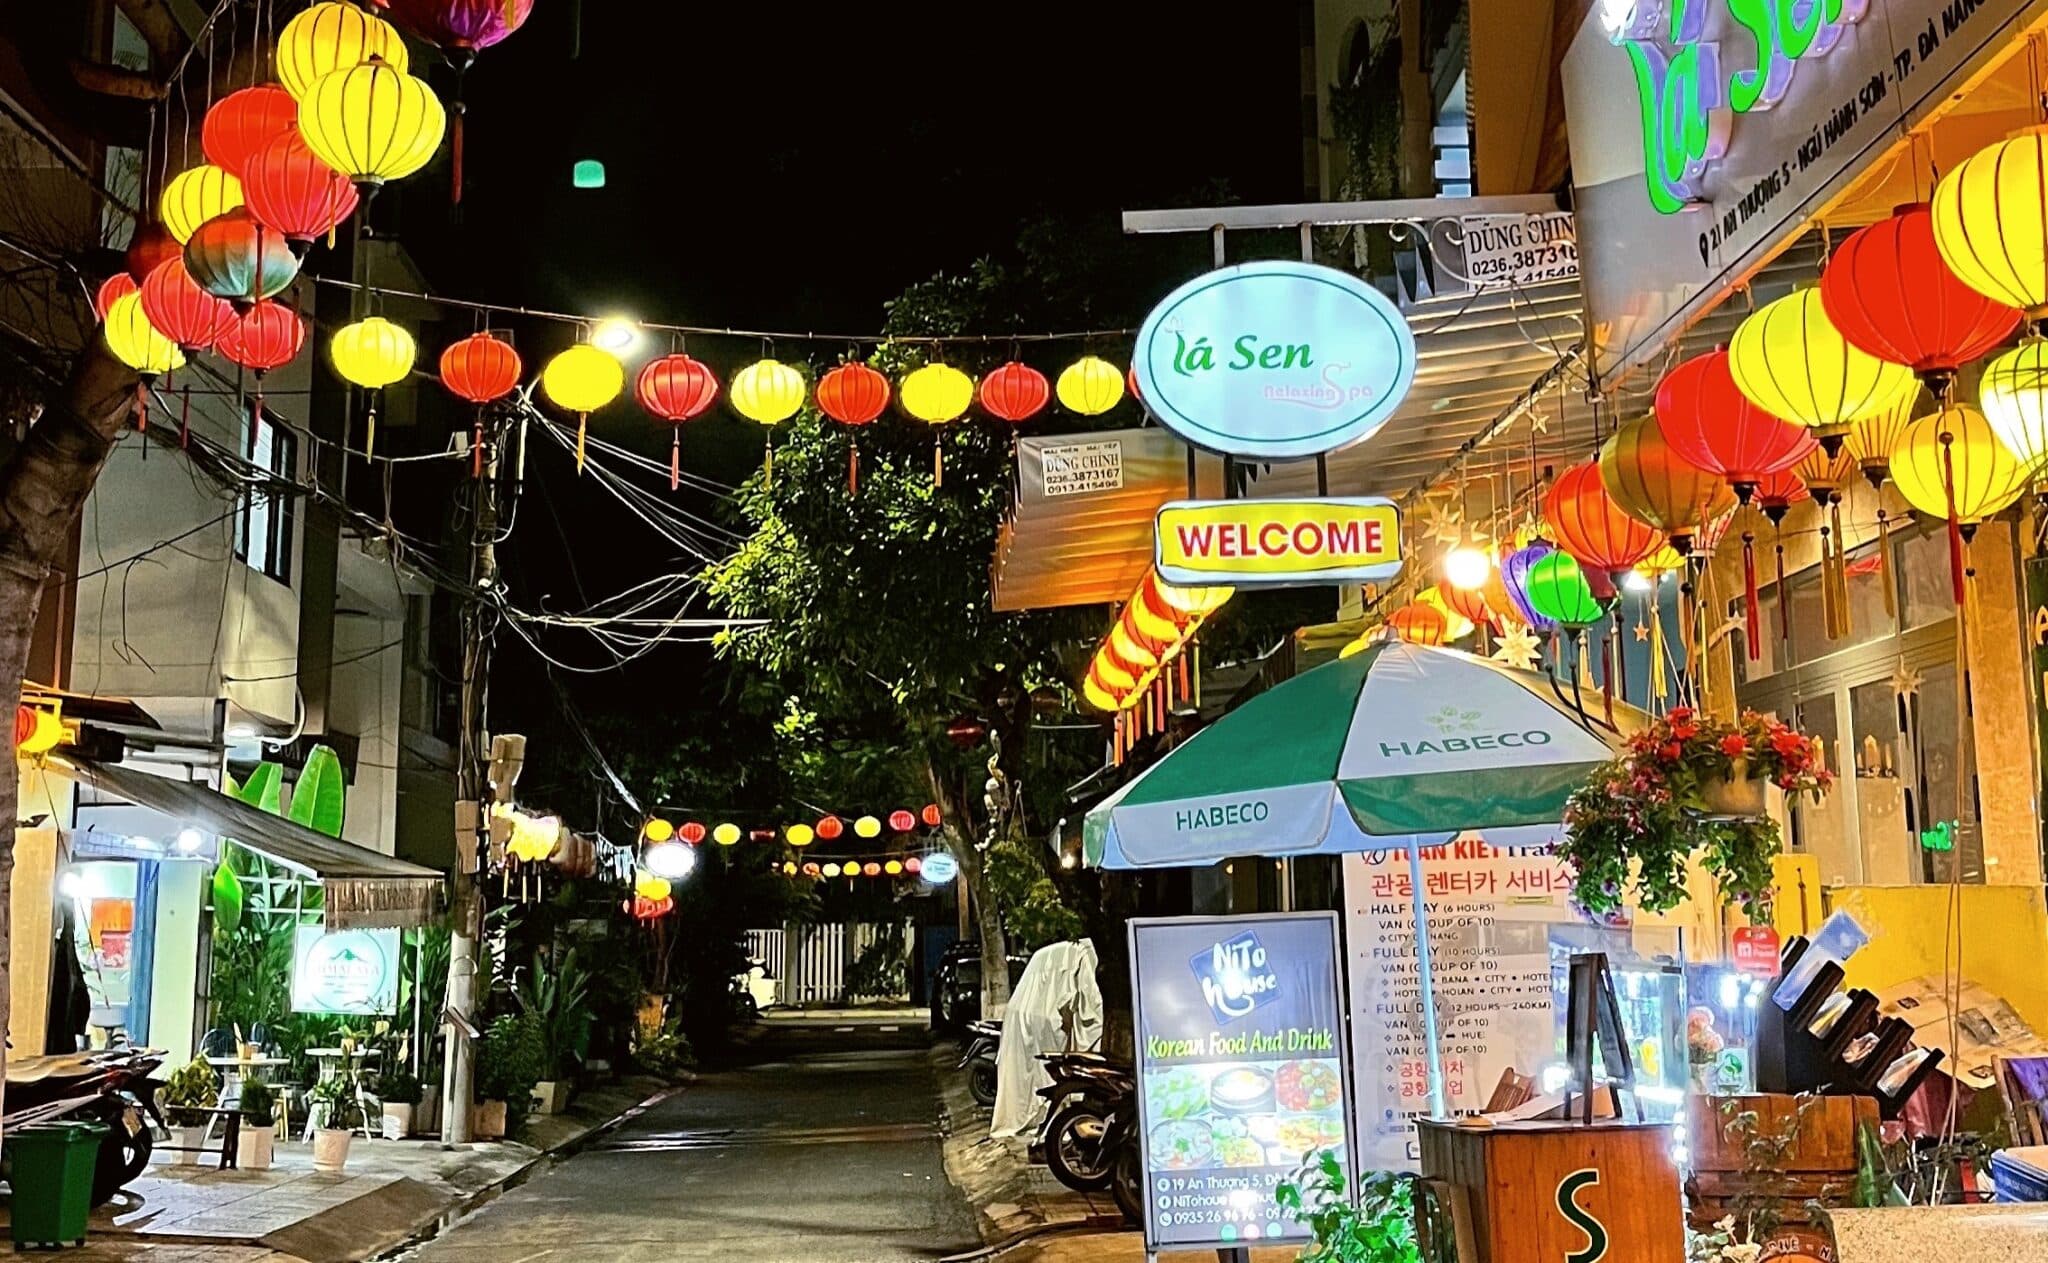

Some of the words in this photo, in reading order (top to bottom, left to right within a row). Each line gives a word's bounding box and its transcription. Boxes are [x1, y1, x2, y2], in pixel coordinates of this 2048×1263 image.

[1710, 223, 1721, 251] 21
[1782, 161, 1790, 186] 5
[1468, 221, 1523, 255] DŨNG
[1228, 334, 1313, 370] Sen
[1264, 384, 1338, 402] Relaxing
[1177, 521, 1383, 558] WELCOME
[1379, 730, 1552, 758] HABECO
[1176, 801, 1269, 831] HABECO
[1427, 869, 1498, 896] 렌터카
[1505, 867, 1573, 894] 서비스
[1371, 902, 1407, 916] HALF
[1412, 902, 1439, 914] AY
[1443, 905, 1454, 914] (6
[1456, 903, 1496, 913] HOURS)
[1379, 920, 1403, 930] VAN
[1407, 918, 1454, 930] (GOUP
[1457, 918, 1474, 928] OF
[1478, 917, 1496, 927] 10)
[1388, 933, 1410, 943] CITY
[1373, 946, 1409, 959] FULL
[1412, 945, 1440, 958] DY
[1462, 947, 1500, 956] HOURS)
[1381, 963, 1405, 974] VAN
[1409, 961, 1457, 974] (GOUP
[1460, 961, 1476, 972] OF
[1480, 960, 1498, 971] 10)
[1394, 976, 1422, 987] HOTE
[1485, 974, 1507, 984] CITY
[1394, 989, 1422, 999] HOTE
[1490, 985, 1512, 995] CITY
[1376, 1002, 1411, 1014] FULL
[1415, 1001, 1442, 1014] DY
[1465, 1002, 1501, 1012] HOURS
[1512, 1001, 1551, 1011] 240KM)
[1384, 1020, 1408, 1030] VAN
[1457, 1018, 1472, 1028] OF
[1474, 1017, 1490, 1027] 10)
[1147, 1034, 1206, 1058] Korean
[1209, 1031, 1247, 1056] Food
[1250, 1029, 1284, 1053] And
[1287, 1027, 1334, 1051] Drink
[1396, 1034, 1411, 1042] DA
[1386, 1046, 1409, 1056] VAN
[1455, 1045, 1469, 1054] OF
[1472, 1045, 1487, 1054] 10)
[1172, 1178, 1185, 1191] 19
[1187, 1179, 1204, 1190] An
[1252, 1175, 1264, 1188] 5,
[1173, 1211, 1204, 1225] 0935
[1206, 1210, 1222, 1223] 26
[1555, 1167, 1609, 1263] S
